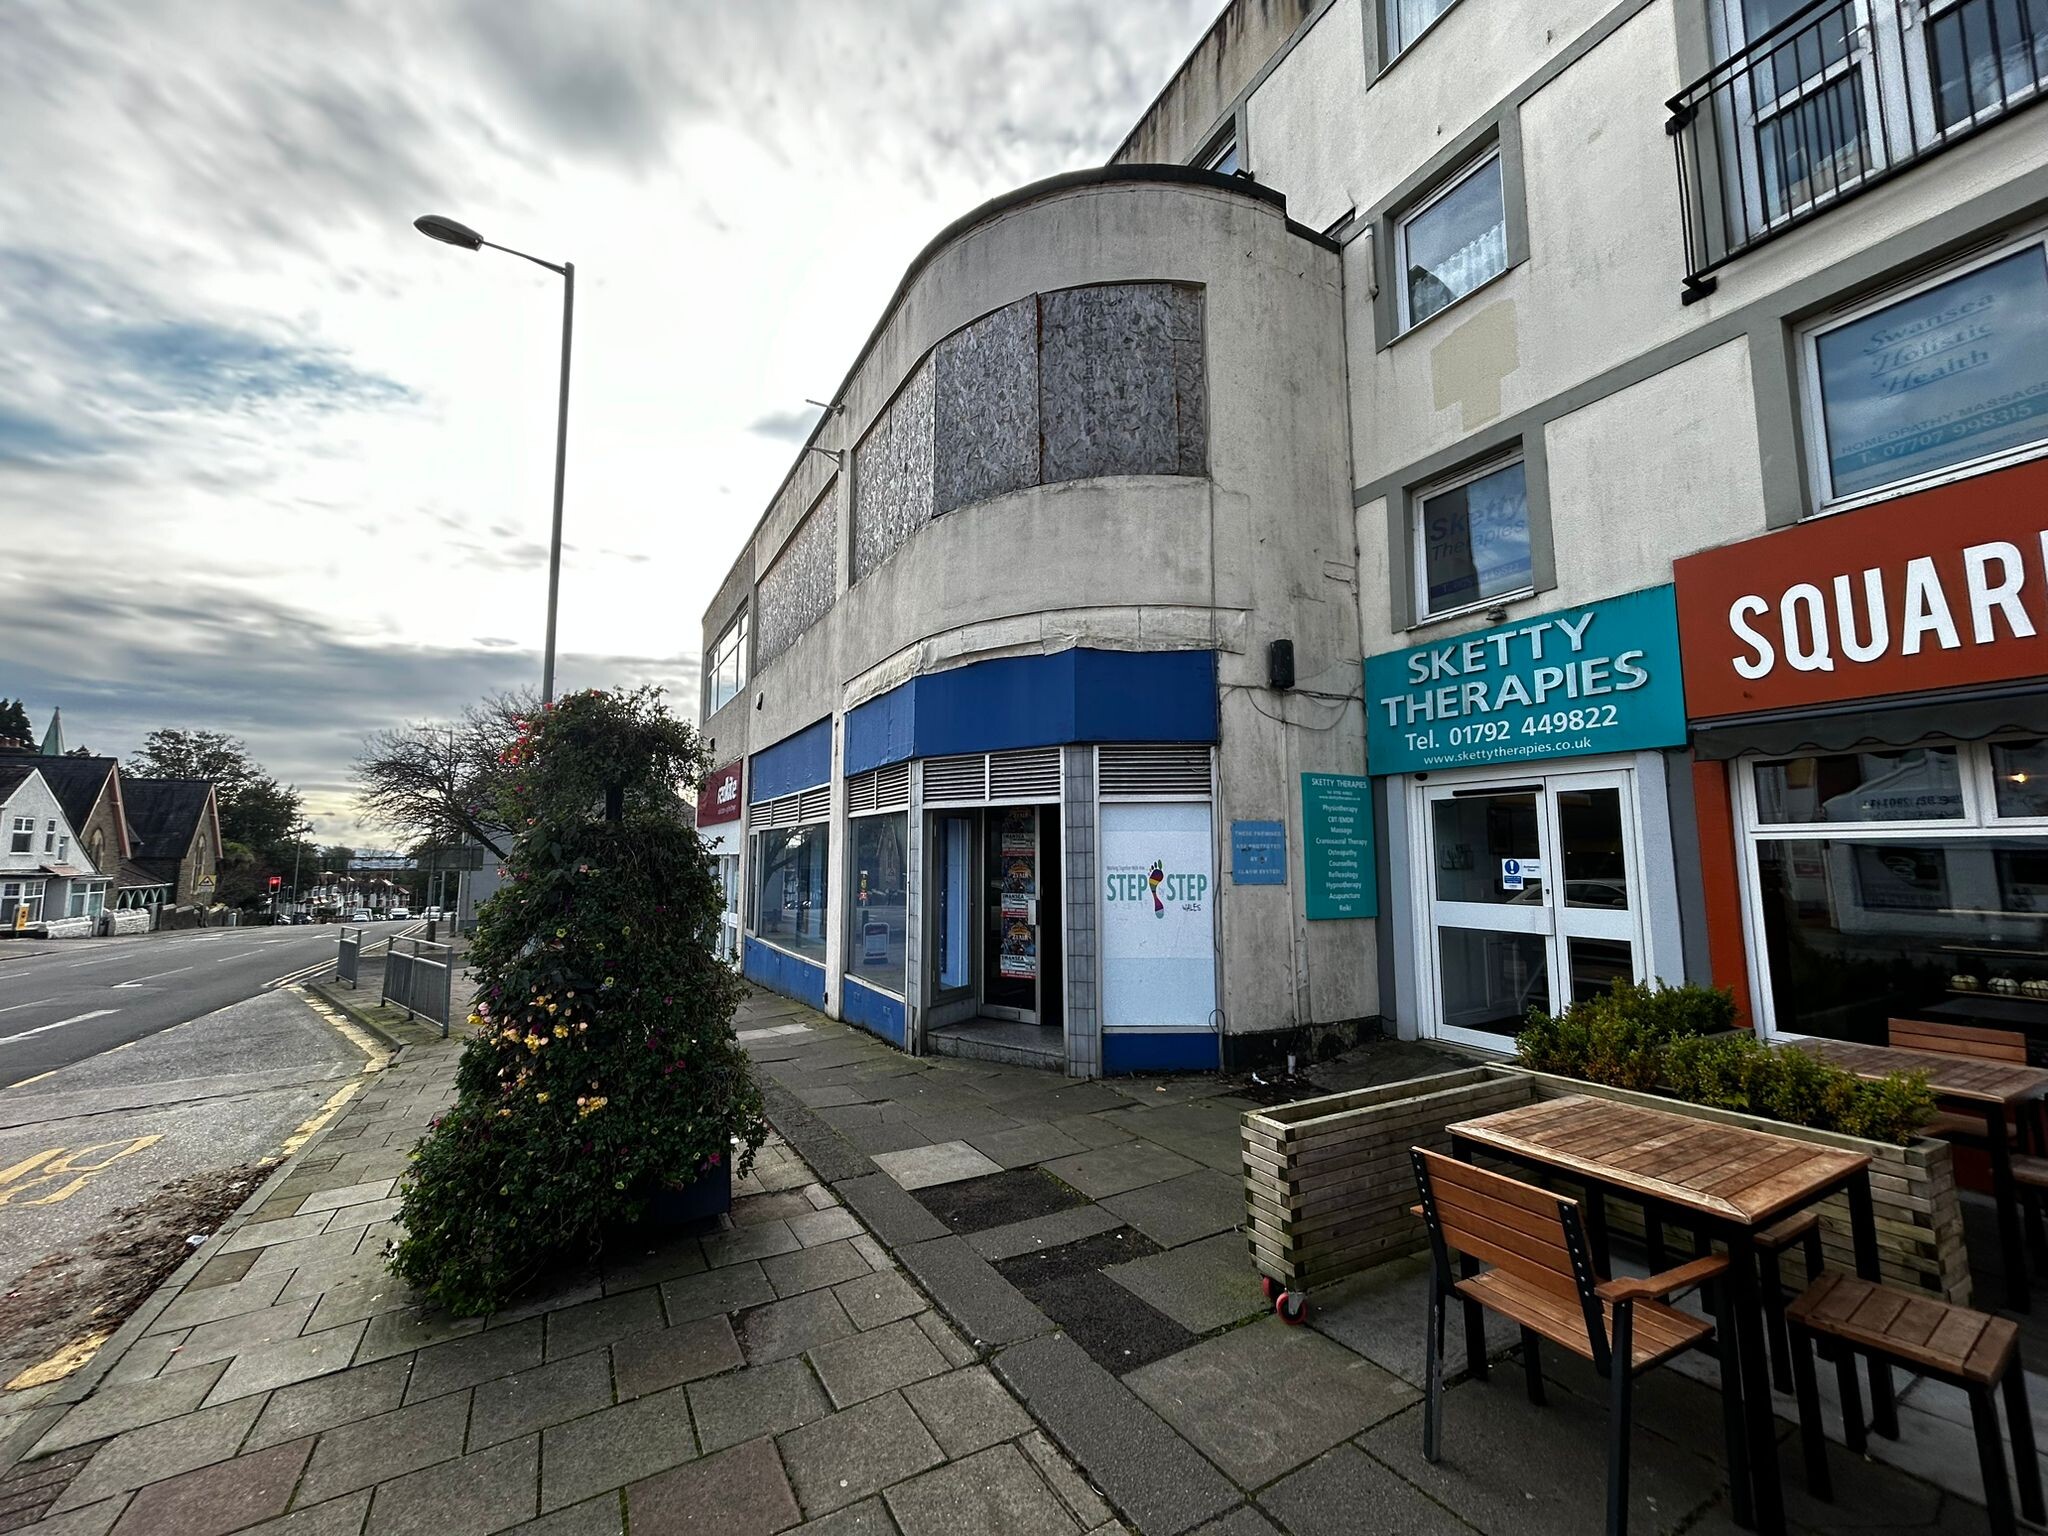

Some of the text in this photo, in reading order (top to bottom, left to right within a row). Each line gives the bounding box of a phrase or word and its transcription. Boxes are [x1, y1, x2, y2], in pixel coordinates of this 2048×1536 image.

[1864, 294, 1994, 354] Swansea
[1871, 322, 1992, 377] Holistic
[1882, 350, 1989, 394] Health
[1841, 413, 1953, 454] HOMEOPATHY
[1729, 530, 2048, 681] SQUAR
[1407, 611, 1595, 685] SKETTY
[1380, 650, 1649, 728] THERAPIES
[1405, 704, 1619, 751] Tel. 01792 449822
[1423, 736, 1592, 766] www.skettytherapies.co.uk
[1311, 778, 1367, 789] SKETTY THERAPIES
[1327, 849, 1358, 857] Osteopathy
[1347, 837, 1368, 847] Therapy
[1107, 873, 1208, 902] STEP STEP
[1328, 871, 1359, 879] Reflexology
